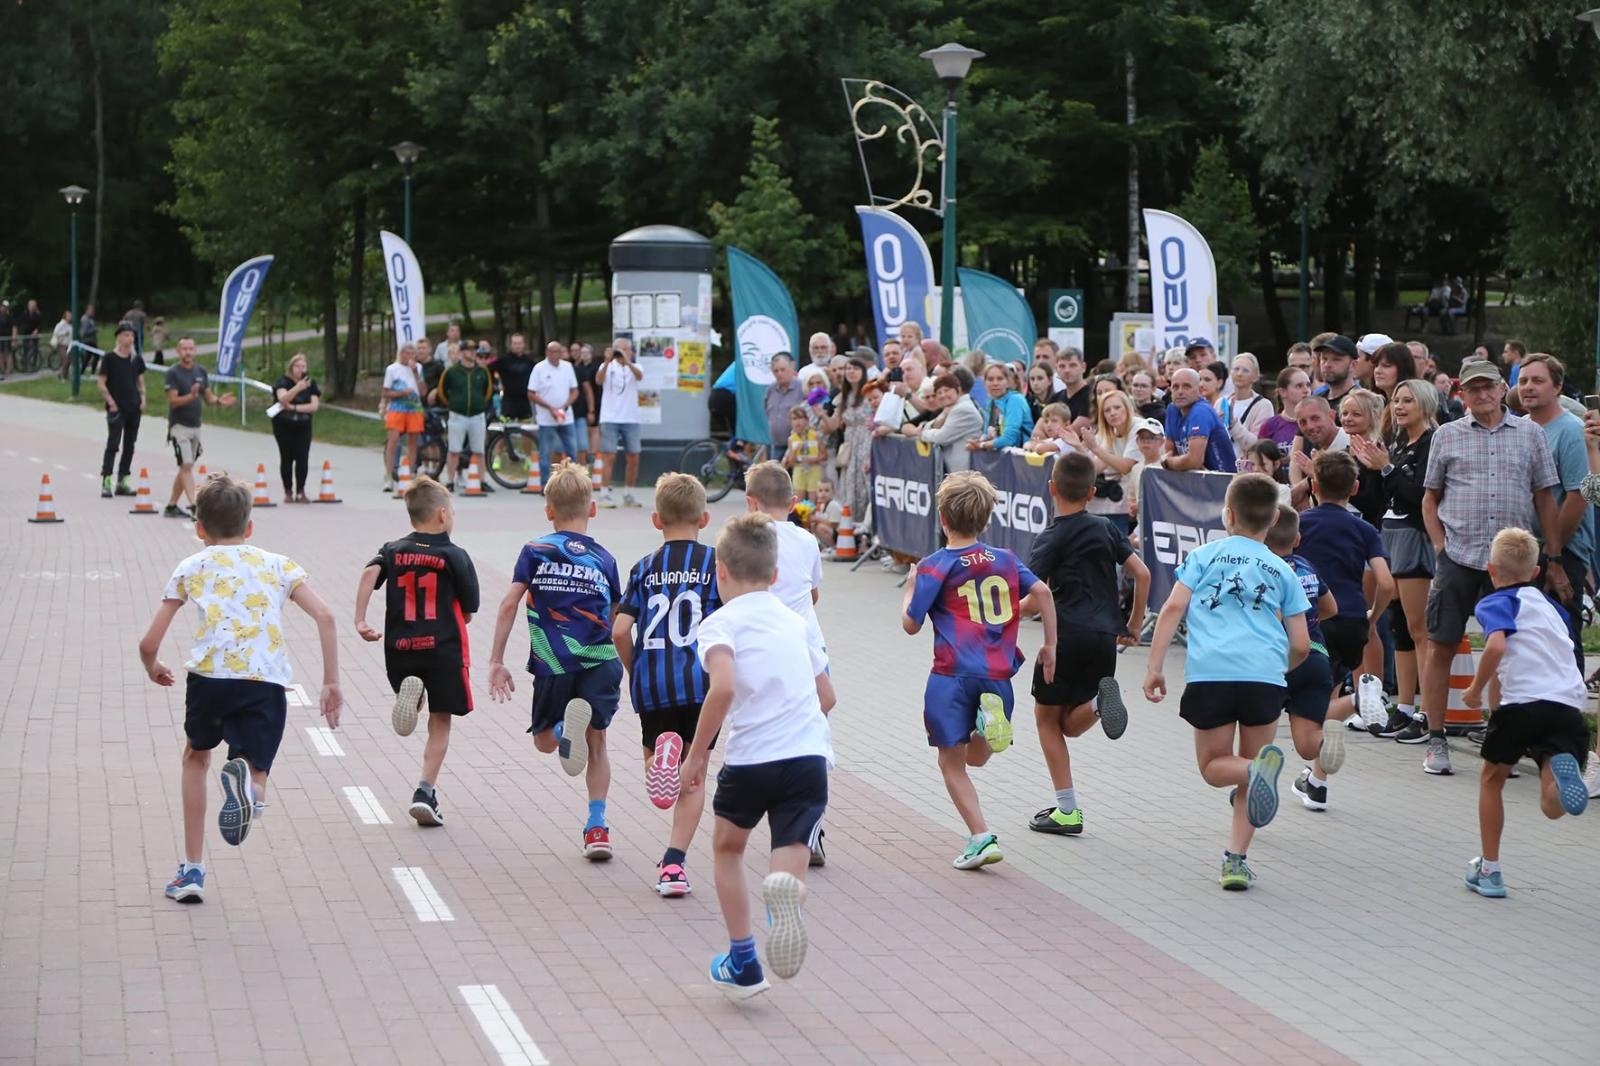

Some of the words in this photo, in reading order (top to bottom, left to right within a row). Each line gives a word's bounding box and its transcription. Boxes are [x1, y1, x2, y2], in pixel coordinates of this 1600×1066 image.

[218, 268, 260, 374] ERIGO
[874, 474, 931, 517] ERIGO
[992, 489, 1048, 534] RIGO
[960, 549, 996, 567] STAŚ
[1255, 557, 1281, 579] Team
[396, 571, 438, 622] 11
[643, 589, 703, 650] 20
[957, 575, 1013, 625] 10
